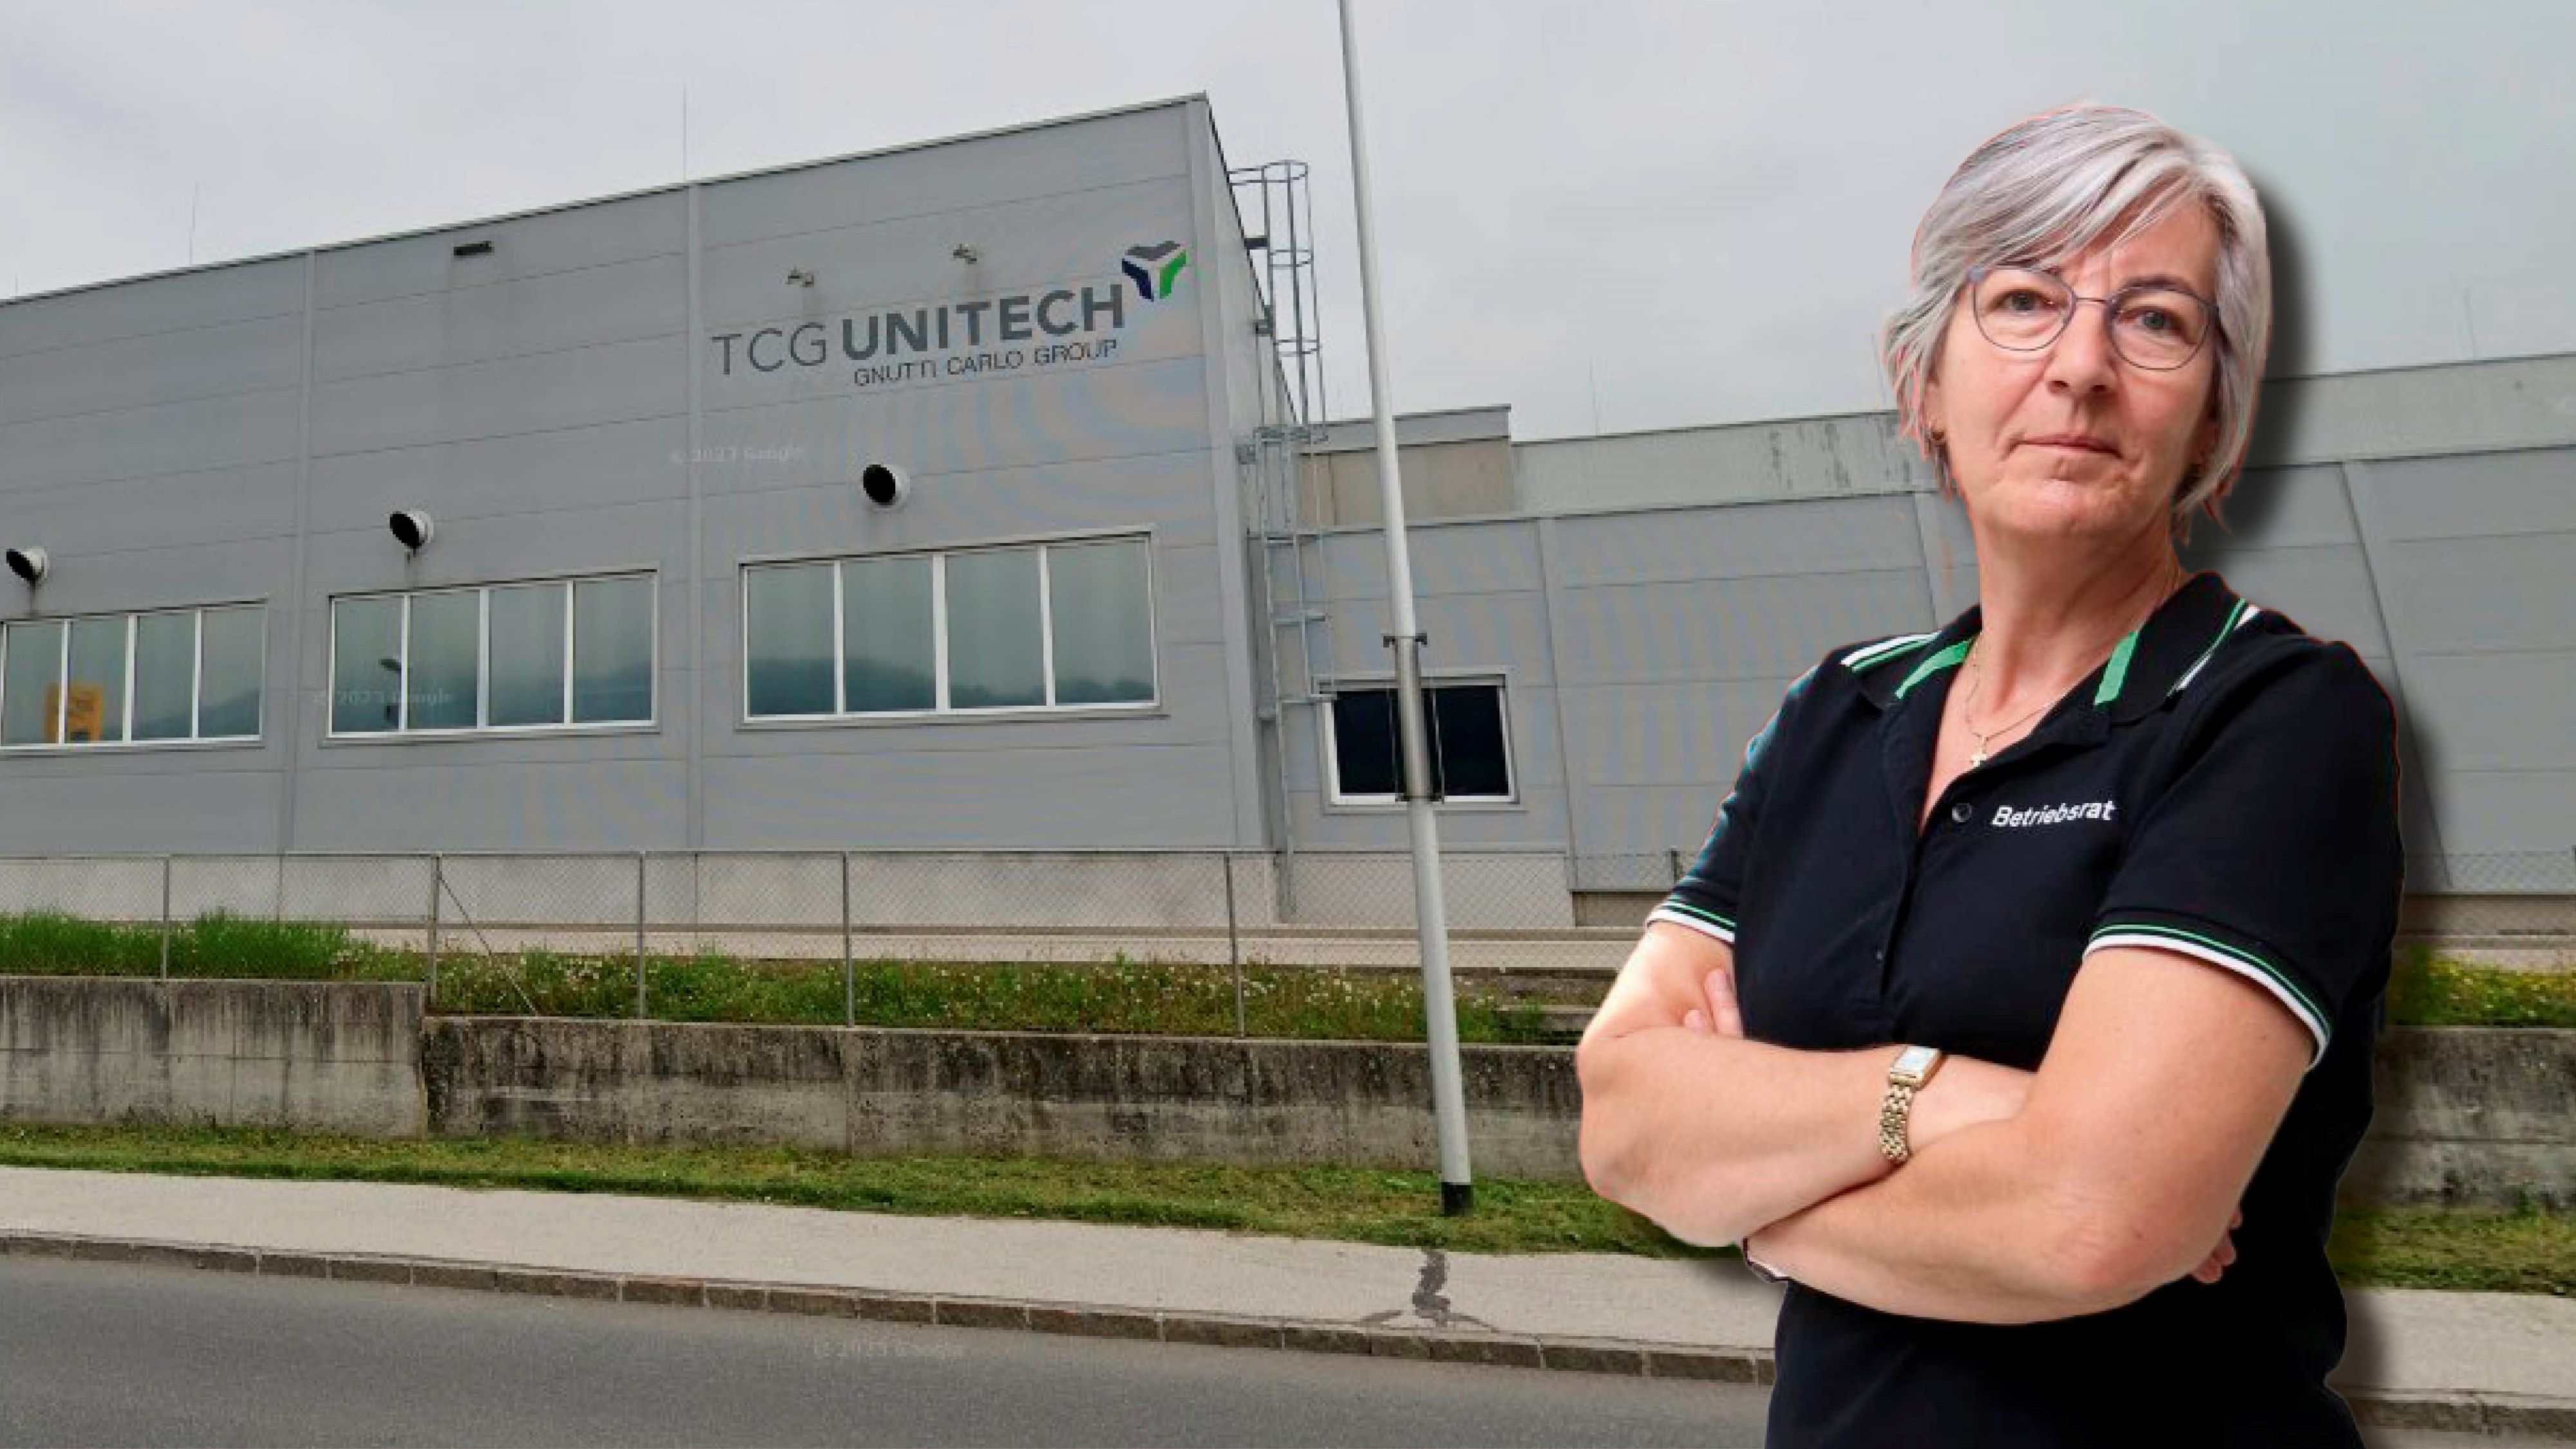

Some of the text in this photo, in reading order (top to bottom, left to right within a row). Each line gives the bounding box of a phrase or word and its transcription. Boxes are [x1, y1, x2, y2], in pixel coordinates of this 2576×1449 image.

[712, 283, 1123, 375] TCG UNITECH
[947, 350, 1024, 375] CARLO
[1034, 339, 1117, 366] GROUP
[1992, 800, 2114, 828] Betriebsrat
